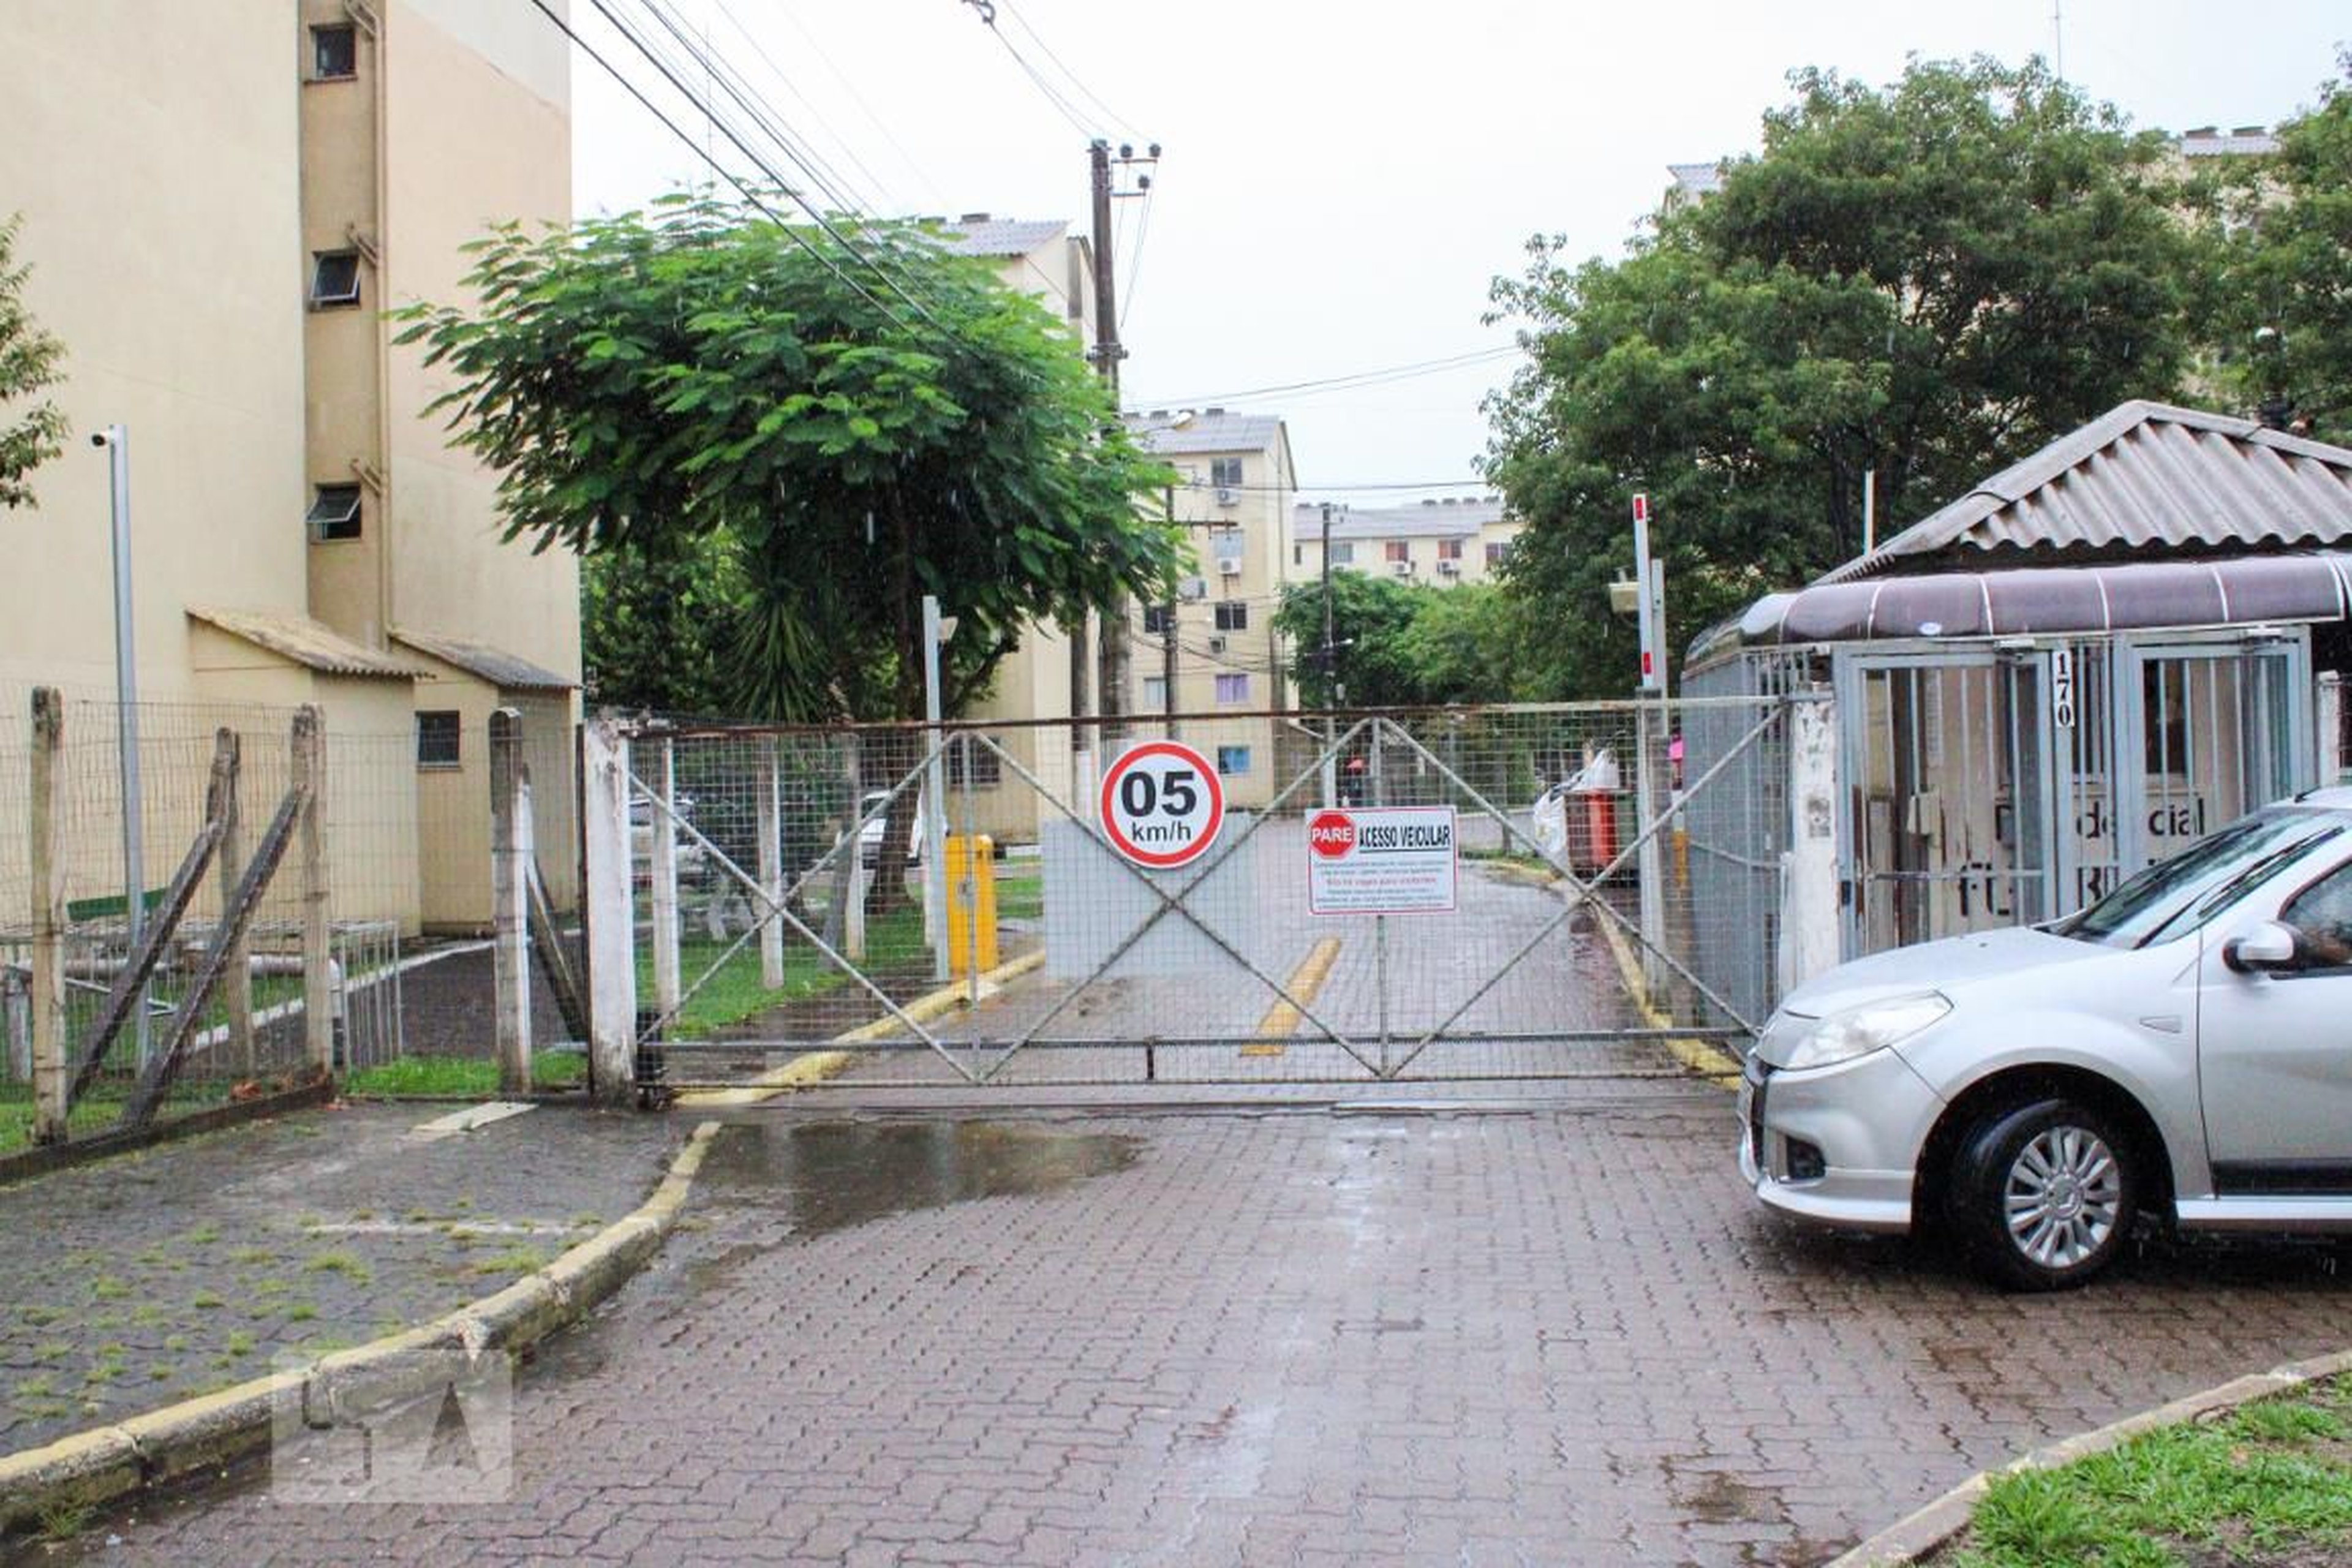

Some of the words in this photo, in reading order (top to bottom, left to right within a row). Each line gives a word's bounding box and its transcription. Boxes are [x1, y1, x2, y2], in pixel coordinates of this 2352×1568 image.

[2057, 653, 2071, 726] 170
[1121, 771, 1196, 817] 05
[1132, 821, 1191, 841] km/h
[1311, 827, 1352, 843] PARE
[1359, 827, 1397, 847] ACESSO
[1400, 825, 1450, 846] VEICULAR
